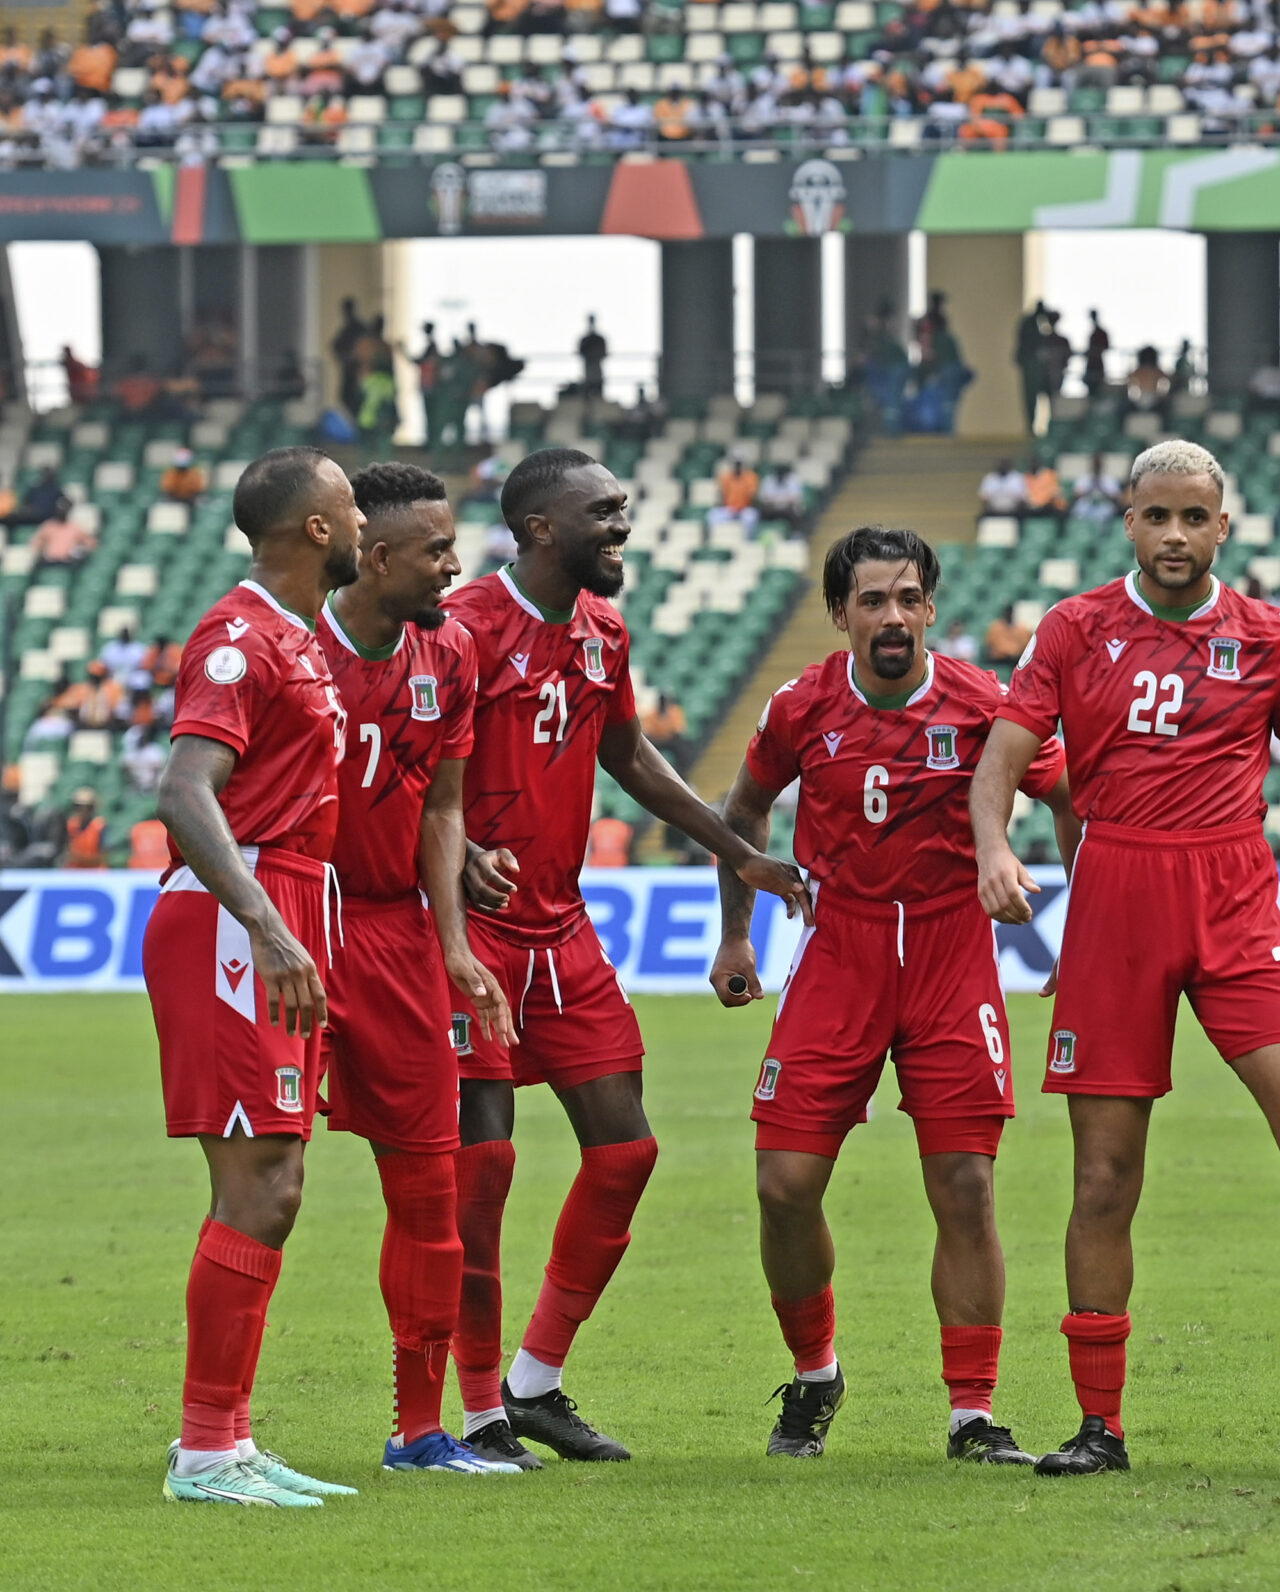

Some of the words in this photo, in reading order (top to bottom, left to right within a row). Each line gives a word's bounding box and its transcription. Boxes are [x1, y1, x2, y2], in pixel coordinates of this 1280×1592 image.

[533, 680, 568, 744] 21
[1127, 670, 1184, 736] 22
[359, 722, 382, 788] 7
[863, 765, 890, 824] 6
[978, 1003, 1004, 1064] 6
